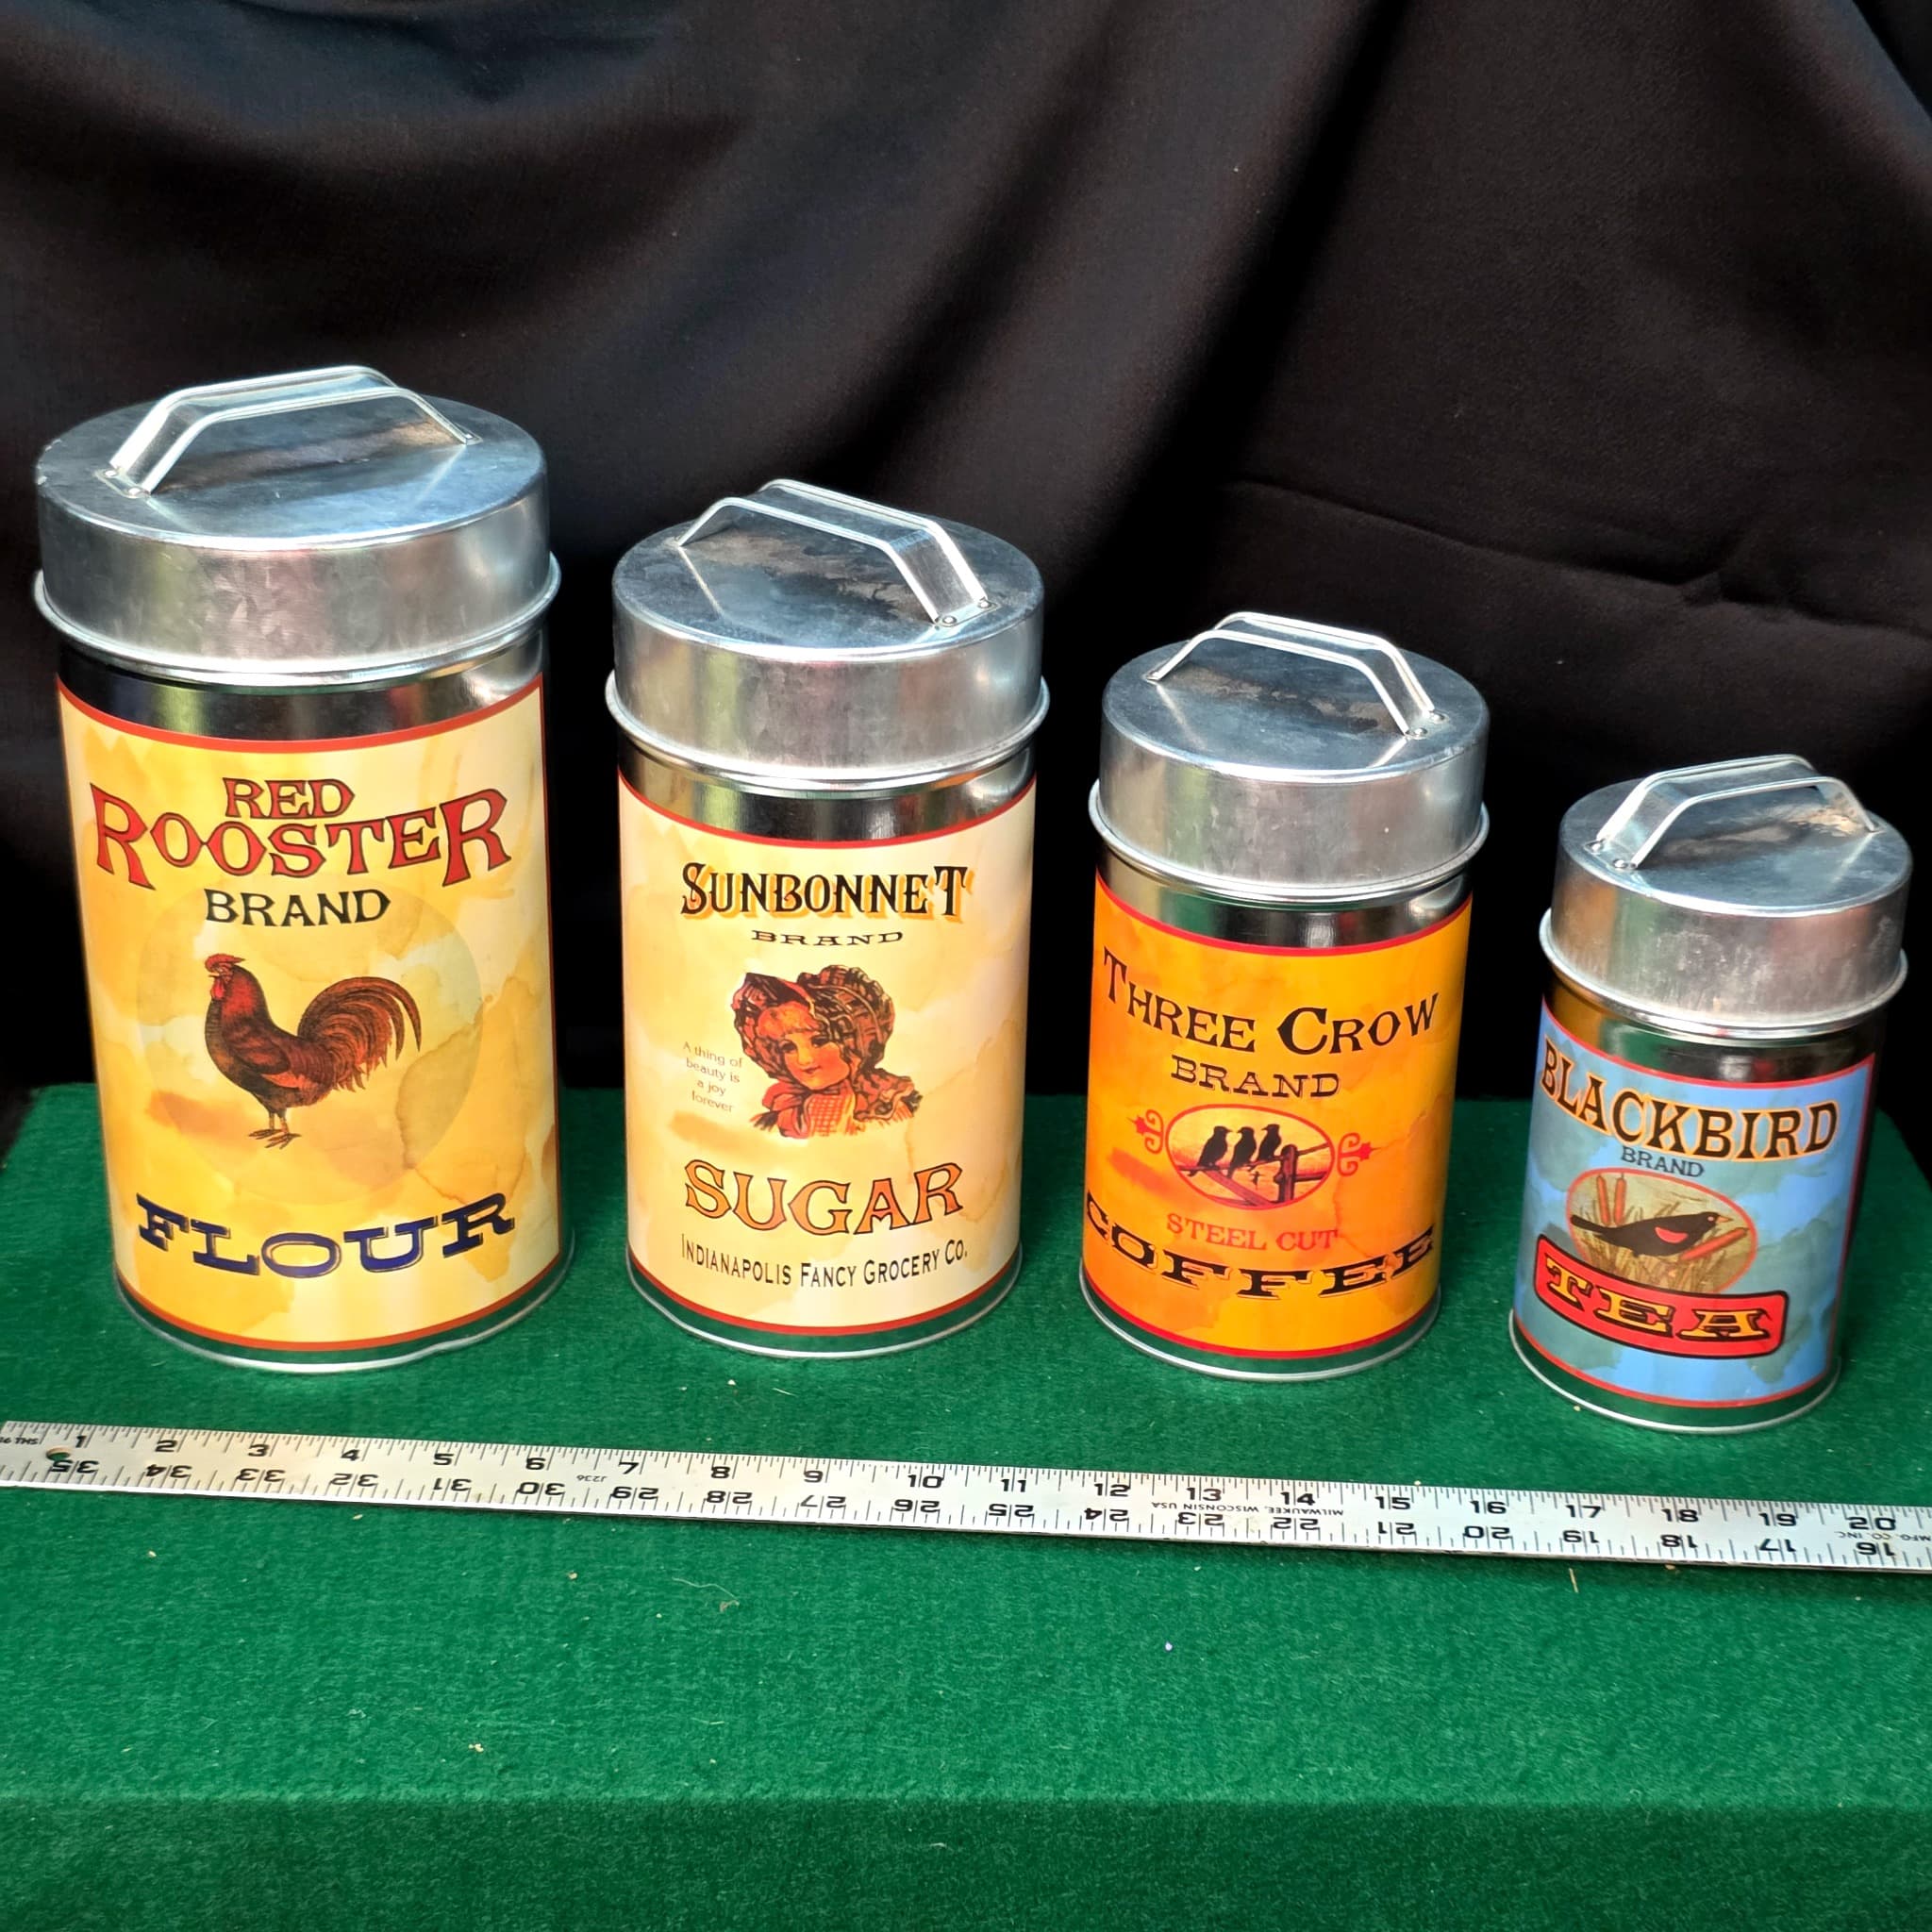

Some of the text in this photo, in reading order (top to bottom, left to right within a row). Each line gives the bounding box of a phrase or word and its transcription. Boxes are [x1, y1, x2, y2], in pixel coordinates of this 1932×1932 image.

[223, 777, 356, 819] RED
[91, 782, 511, 890] ROOSTER
[204, 889, 391, 927] BRAND
[681, 862, 971, 922] SUNBONNET
[752, 929, 903, 946] BRAND
[1104, 946, 1440, 1056] THREE CROW
[683, 1041, 742, 1068] A thing of
[686, 1057, 741, 1083] beauty is
[1171, 1055, 1341, 1098] BRAND
[691, 1090, 733, 1113] forever
[708, 1081, 726, 1096] joy
[1541, 1038, 1839, 1160] BLACKBIRD
[1621, 1145, 1705, 1177] BRAND
[684, 1158, 963, 1235] SUGAR
[136, 1192, 515, 1278] FLOUR
[1087, 1191, 1435, 1301] COFFEE
[1166, 1213, 1339, 1251] STEEL CUT
[681, 1233, 968, 1288] INDIANAPOLIS FANCY GROCERY CO.
[1545, 1254, 1770, 1341] TEA
[75, 1435, 1896, 1530] 1 2 3 4 5 6 7 8 9 10 11 12 13 14 15 16 17 18 19 20
[50, 1459, 1895, 1557] 16 17 18 19 20 21 22 23 24 25 26 27 28 29 30 31 32 33 34 35
[1183, 1503, 1259, 1513] WISCONSIN
